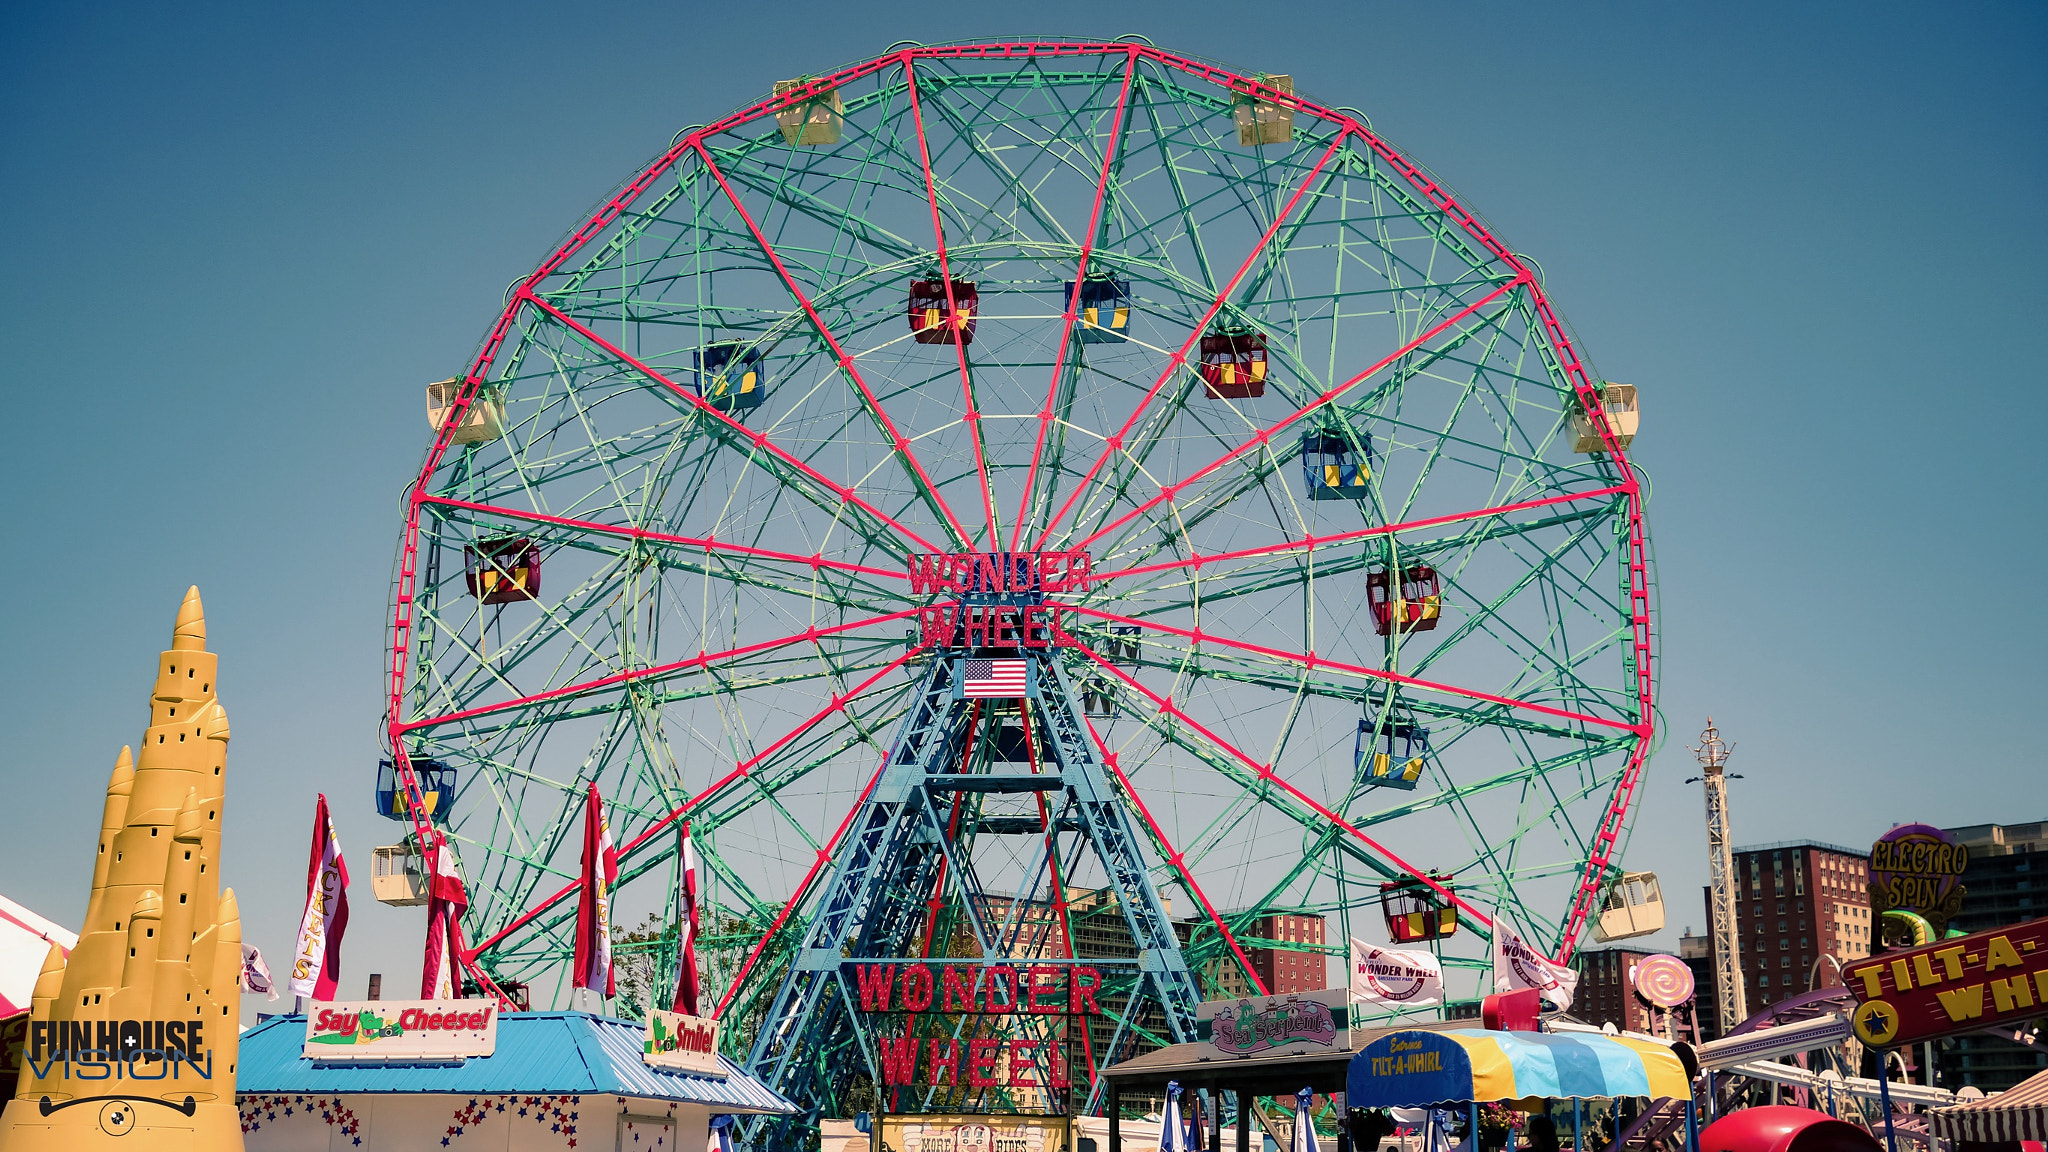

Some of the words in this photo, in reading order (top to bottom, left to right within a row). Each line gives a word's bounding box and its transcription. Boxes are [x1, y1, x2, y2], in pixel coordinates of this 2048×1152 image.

[907, 552, 1091, 594] WONDER
[919, 606, 1078, 648] WHEEL
[1870, 840, 1968, 875] ELECTRO
[292, 824, 337, 980] CKETS
[1888, 876, 1941, 908] SPIN
[1358, 963, 1402, 976] WONDER
[1405, 966, 1438, 978] WHEEL
[856, 963, 1101, 1014] WONDER
[314, 1009, 359, 1036] Say
[399, 1007, 493, 1031] Cheese!
[676, 1021, 715, 1054] Smile!
[1221, 1024, 1253, 1044] Sea
[1255, 1013, 1323, 1040] Serpent
[880, 1037, 1071, 1088] WHEEL
[1371, 1051, 1442, 1077] TILT-A-WHIRL
[921, 1138, 952, 1152] MORE
